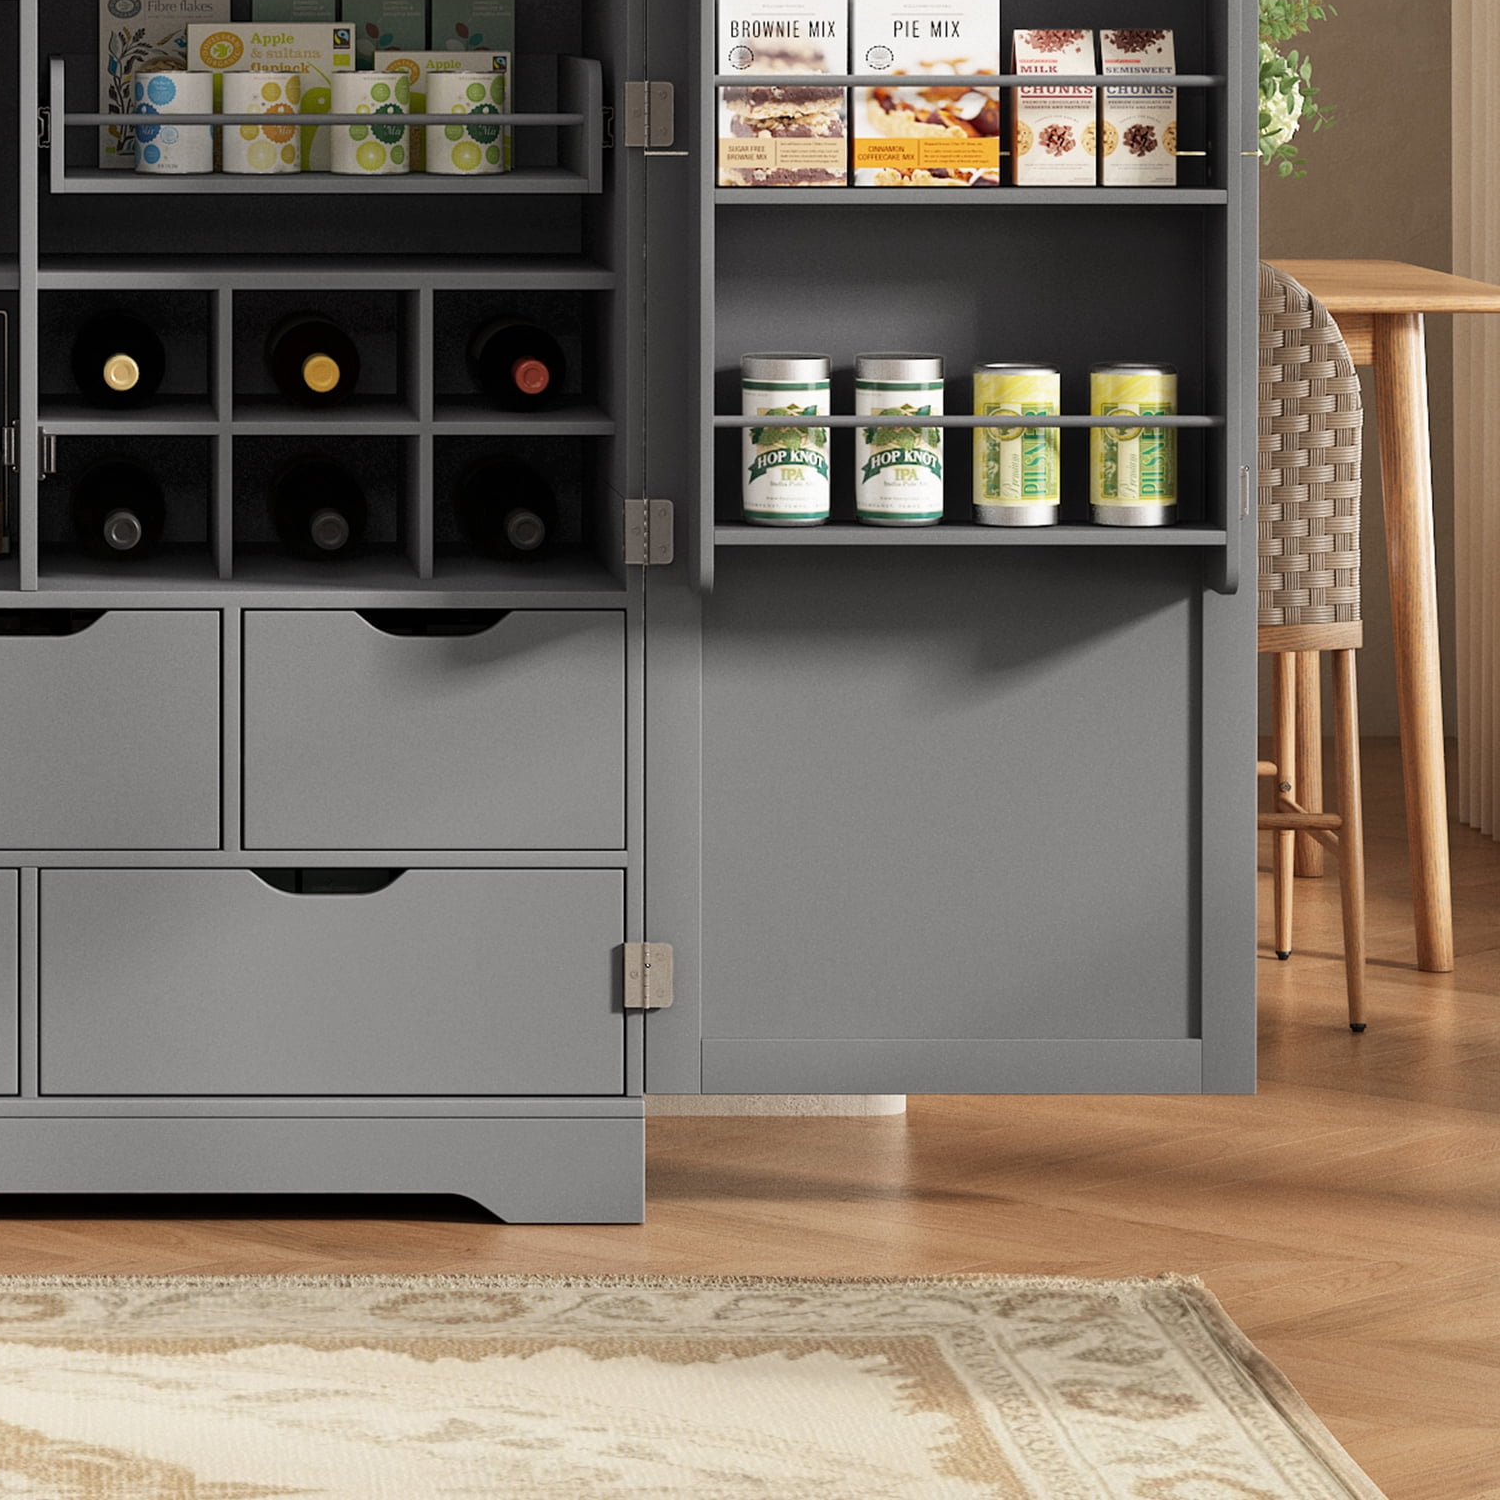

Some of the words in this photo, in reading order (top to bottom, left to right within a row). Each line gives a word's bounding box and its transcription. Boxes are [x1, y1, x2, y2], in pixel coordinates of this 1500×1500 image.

[147, 0, 177, 12] Fibre
[180, 0, 213, 12] flakes
[730, 20, 800, 38] BROWNIE
[809, 20, 836, 38] MIX
[893, 20, 920, 38] PIE
[930, 20, 960, 38] MIX
[250, 33, 294, 46] Apple
[251, 49, 263, 59] &
[266, 48, 321, 59] sultana
[426, 59, 461, 70] Apple
[1105, 66, 1173, 74] SEMISWEET
[1020, 85, 1093, 94] CHUNKS
[1106, 85, 1174, 94] CHUNKS
[757, 450, 787, 469] HOP
[790, 450, 823, 468] KNOT
[871, 450, 901, 469] HOP
[904, 450, 937, 468] KNOT
[781, 468, 805, 480] IPA
[894, 468, 919, 480] IPA
